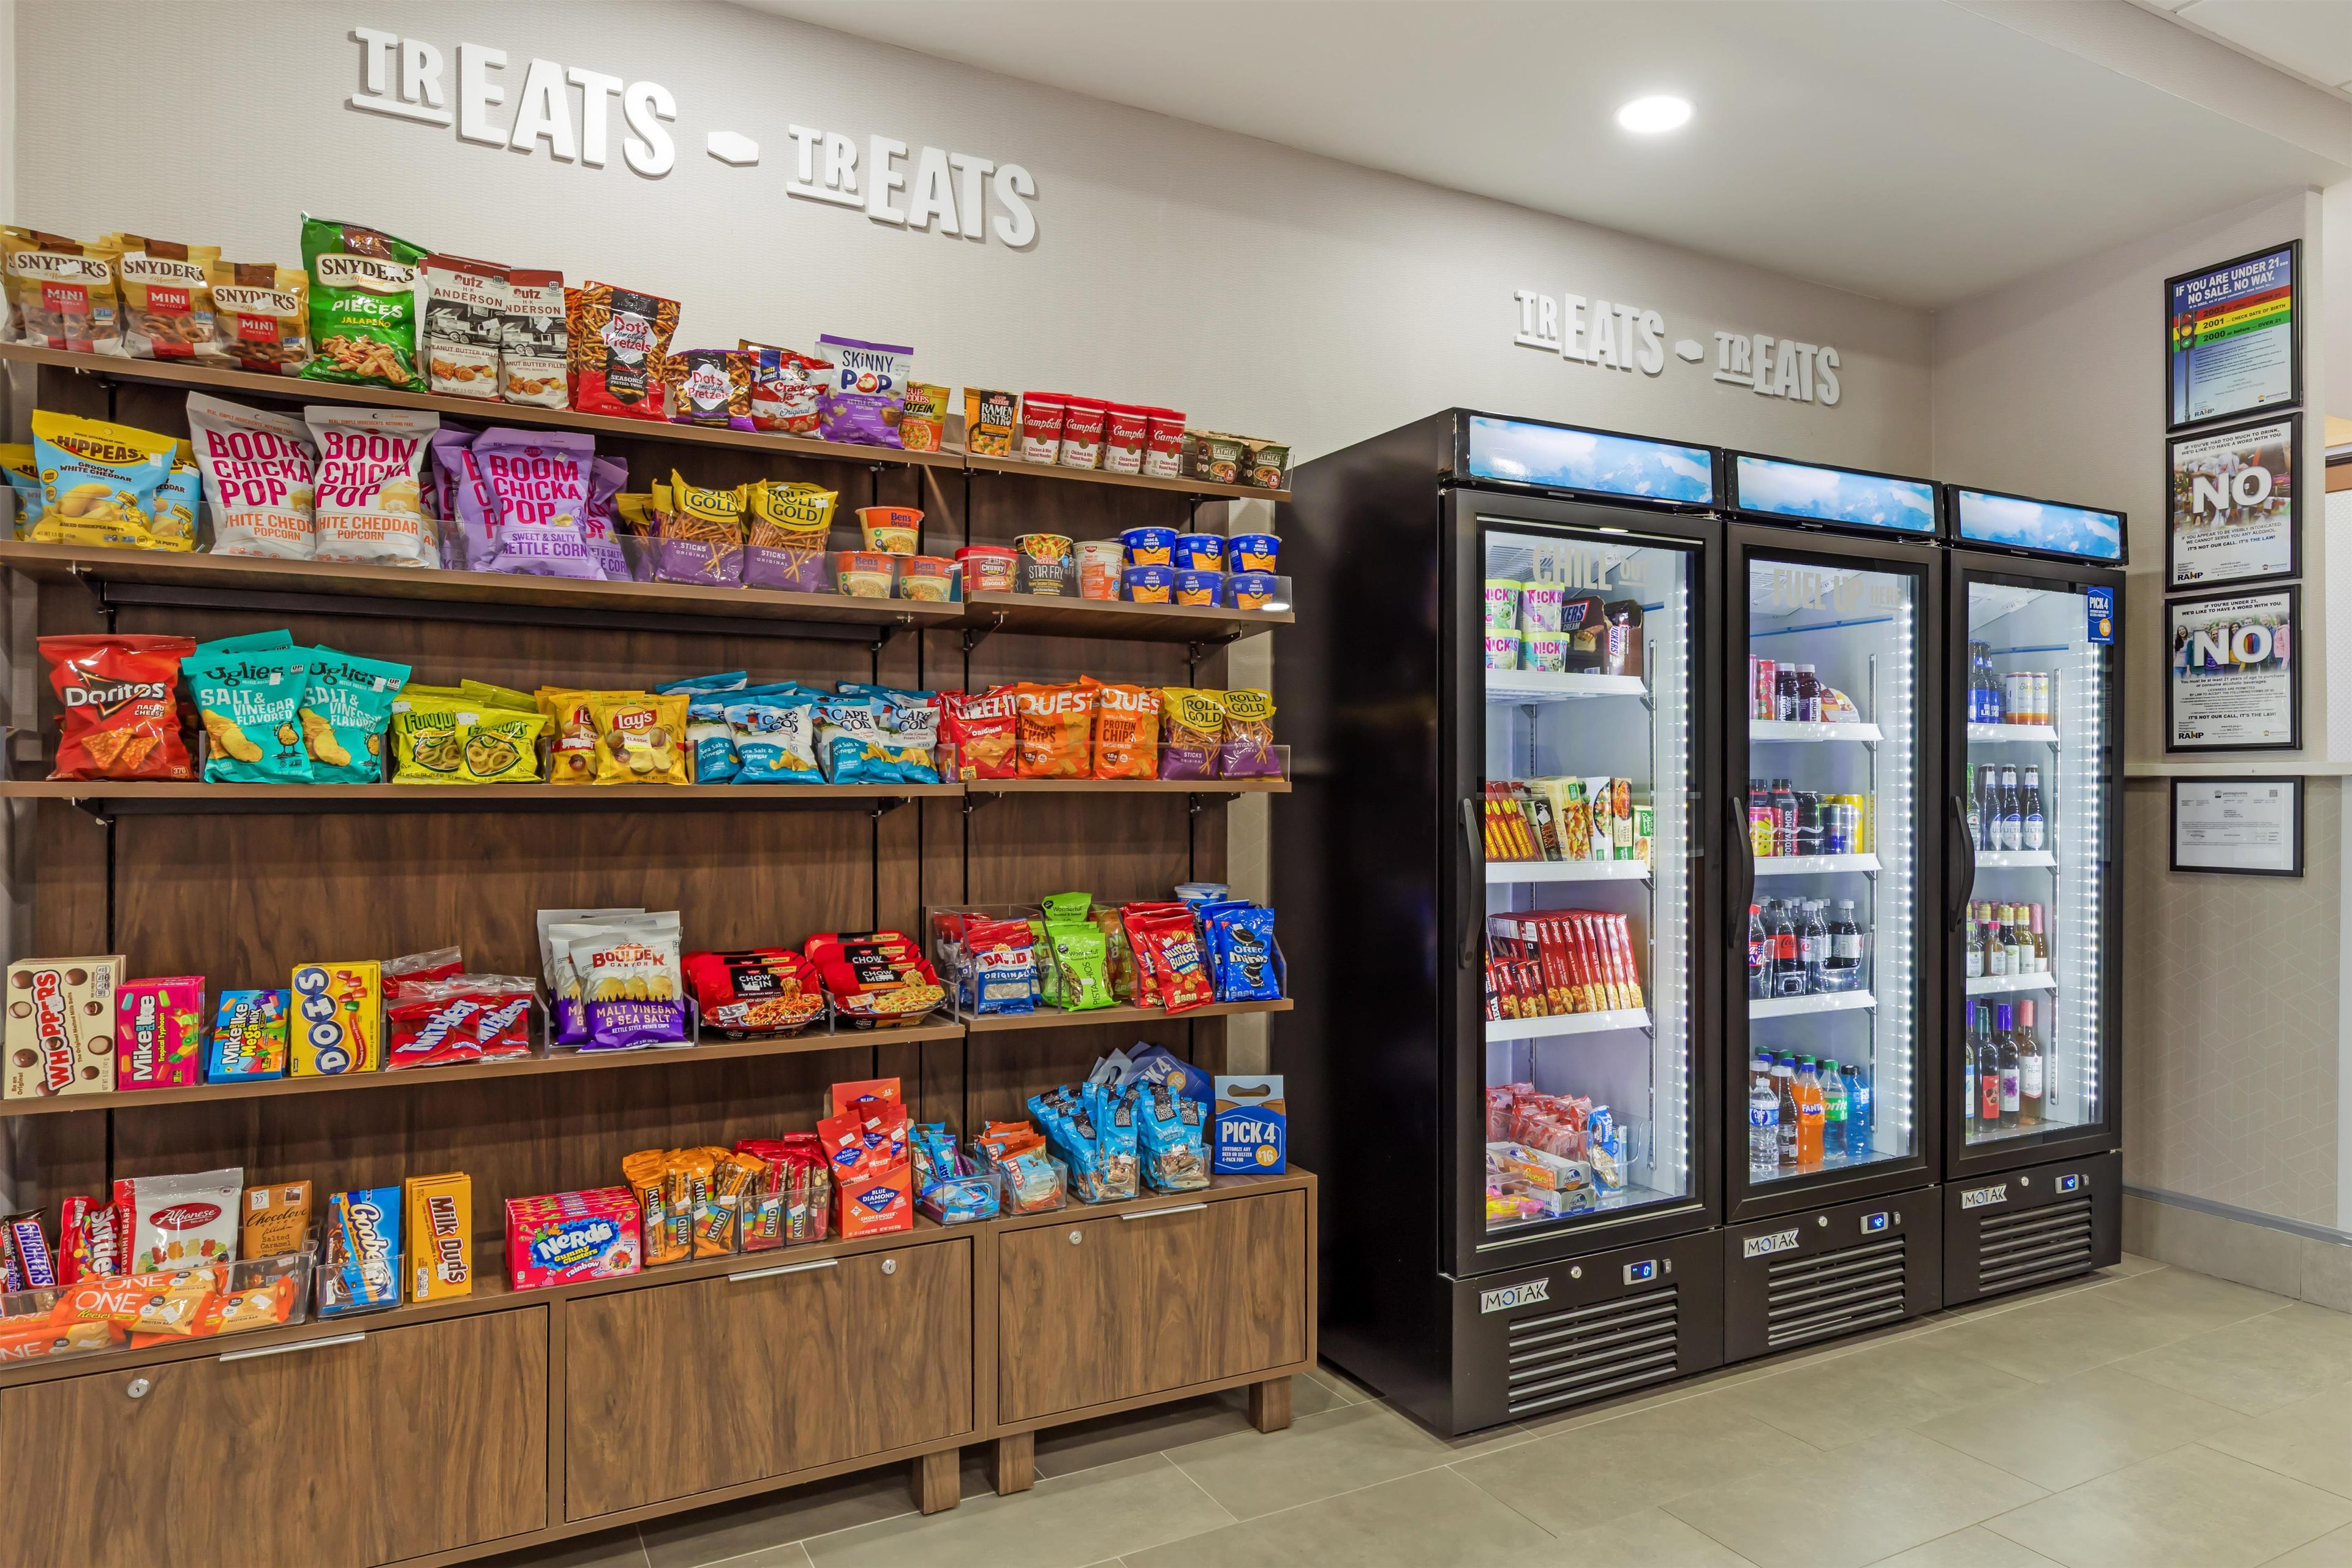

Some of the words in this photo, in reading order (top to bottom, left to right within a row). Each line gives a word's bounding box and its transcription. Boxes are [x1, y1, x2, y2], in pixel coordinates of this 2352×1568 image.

[353, 26, 677, 177] TREATS
[785, 123, 1038, 248] TREATS
[124, 260, 206, 282] SNYDER'S
[2176, 286, 2184, 297] IF
[2187, 279, 2206, 293] YOU
[2209, 272, 2229, 285] ARE
[2231, 263, 2266, 280] UNDER
[2268, 257, 2288, 270] 21...
[2188, 293, 2202, 304] NO
[2204, 285, 2231, 300] SALE.
[2234, 279, 2249, 291] NO
[2252, 271, 2274, 285] WAY.
[151, 292, 186, 304] MINI
[434, 288, 502, 307] ANDERSON
[332, 300, 403, 318] PIECES
[341, 317, 390, 328] JALAPEÑO
[2203, 318, 2224, 329] 2001
[2203, 330, 2226, 342] 2000
[2234, 326, 2250, 334] before
[1514, 289, 1665, 378] TREATS
[1713, 330, 1840, 406] TREATS
[611, 375, 643, 384] SEASONED
[981, 403, 1014, 416] RAMEN
[57, 435, 138, 459] HIPPEAS
[60, 465, 88, 473] WHITE
[90, 469, 132, 482] CHEDDAR
[78, 462, 115, 473] GROOVY
[491, 455, 579, 482] BOOM
[493, 478, 582, 501] CHICKA
[2192, 466, 2272, 514] NO
[500, 497, 556, 526] POP
[891, 512, 911, 521] Ben's
[512, 533, 540, 541] SWEET
[551, 533, 575, 542] SALTY
[554, 543, 587, 557] CORN
[761, 550, 786, 559] STICKS
[756, 557, 788, 567] ORIGINAL
[1532, 544, 1612, 591] CHILL
[1773, 568, 1826, 611] FUEL
[1833, 575, 1863, 612] UP
[2089, 597, 2103, 609] PICK
[2104, 598, 2108, 609] 4
[2193, 624, 2272, 666] NO
[66, 682, 167, 708] Doritos
[200, 688, 252, 706] SALT
[254, 692, 266, 704] &
[1228, 694, 1262, 703] ROLD
[233, 698, 295, 715] VINEGAR
[831, 709, 869, 720] CAPE
[1232, 703, 1265, 712] GOLD
[236, 709, 293, 725] FLAVORED
[617, 711, 655, 731] Lay's
[840, 719, 871, 731] COD
[1104, 720, 1136, 730] PROTEIN
[1162, 943, 1196, 960] Nutter
[1234, 945, 1264, 954] OREO
[592, 949, 665, 968] BOULDER
[1170, 952, 1199, 970] Butter
[739, 974, 771, 983] CHOW
[984, 970, 1029, 979] ORIGINAL
[597, 1005, 627, 1018] MALT
[632, 1005, 678, 1014] VINEGAR
[606, 1016, 612, 1027] &
[617, 1014, 639, 1025] SEA
[1222, 1121, 1262, 1143] PICK
[1264, 1123, 1276, 1144] 4
[1258, 1150, 1274, 1162] $16
[862, 1192, 895, 1202] DIAMOND
[1965, 1186, 2004, 1207] MOTAK
[156, 1208, 216, 1225] Albanese
[427, 1194, 456, 1237] Milk
[860, 1212, 895, 1221] SMOKEHOUSE
[677, 1218, 688, 1245] KIND
[260, 1240, 291, 1250] Caramel
[1747, 1231, 1796, 1254] MOTAK
[16, 1223, 55, 1286] SNICKERS
[554, 1245, 590, 1262] Gummy
[563, 1249, 598, 1264] Clusters
[566, 1261, 600, 1278] rainbow
[1485, 1283, 1547, 1310] MOTAK
